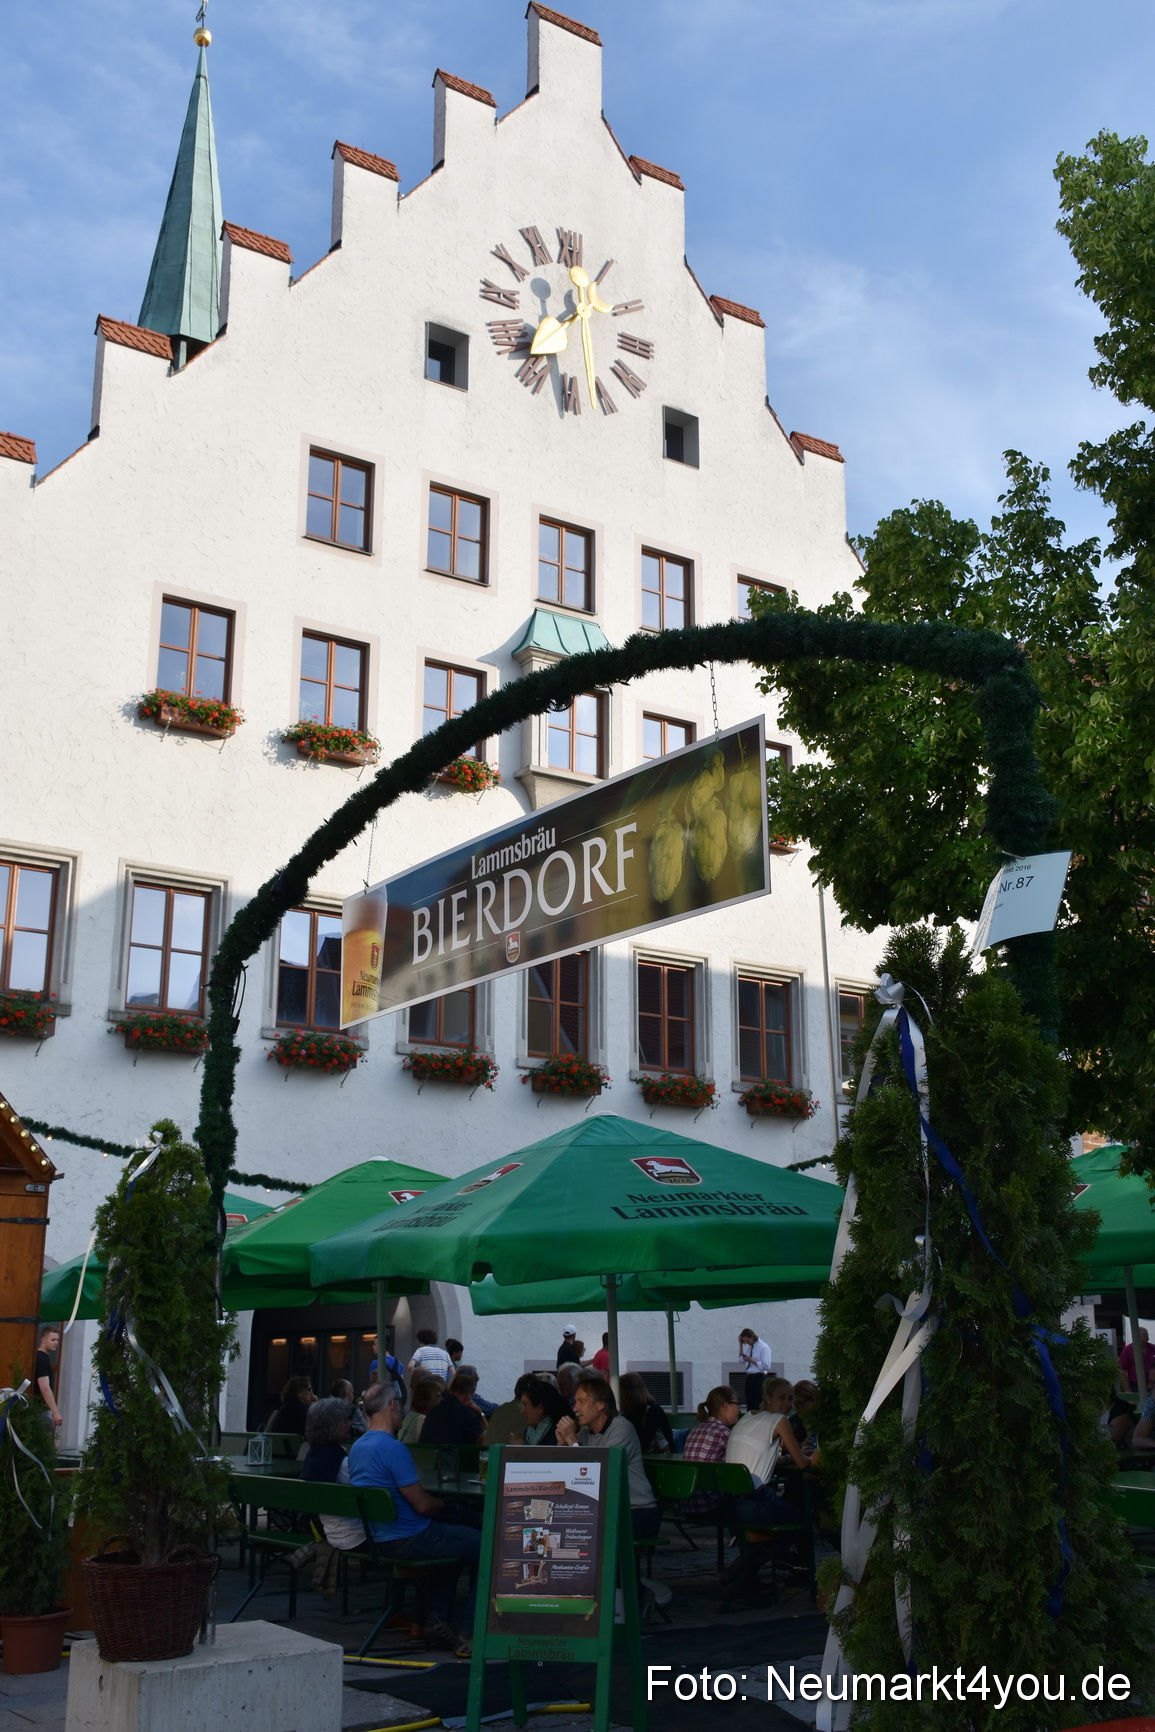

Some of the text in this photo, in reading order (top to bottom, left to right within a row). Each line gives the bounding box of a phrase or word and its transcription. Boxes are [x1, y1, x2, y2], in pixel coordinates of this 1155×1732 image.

[471, 825, 556, 880] Lammsbräu
[1015, 864, 1031, 872] 2016
[412, 822, 638, 966] BIERDORF
[626, 1190, 766, 1204] Neumarkter
[610, 1201, 809, 1220] Lammsbräu
[538, 1484, 561, 1492] Bierdorf
[518, 1637, 568, 1647] Neumarkter
[507, 1647, 574, 1660] Lammsbräu
